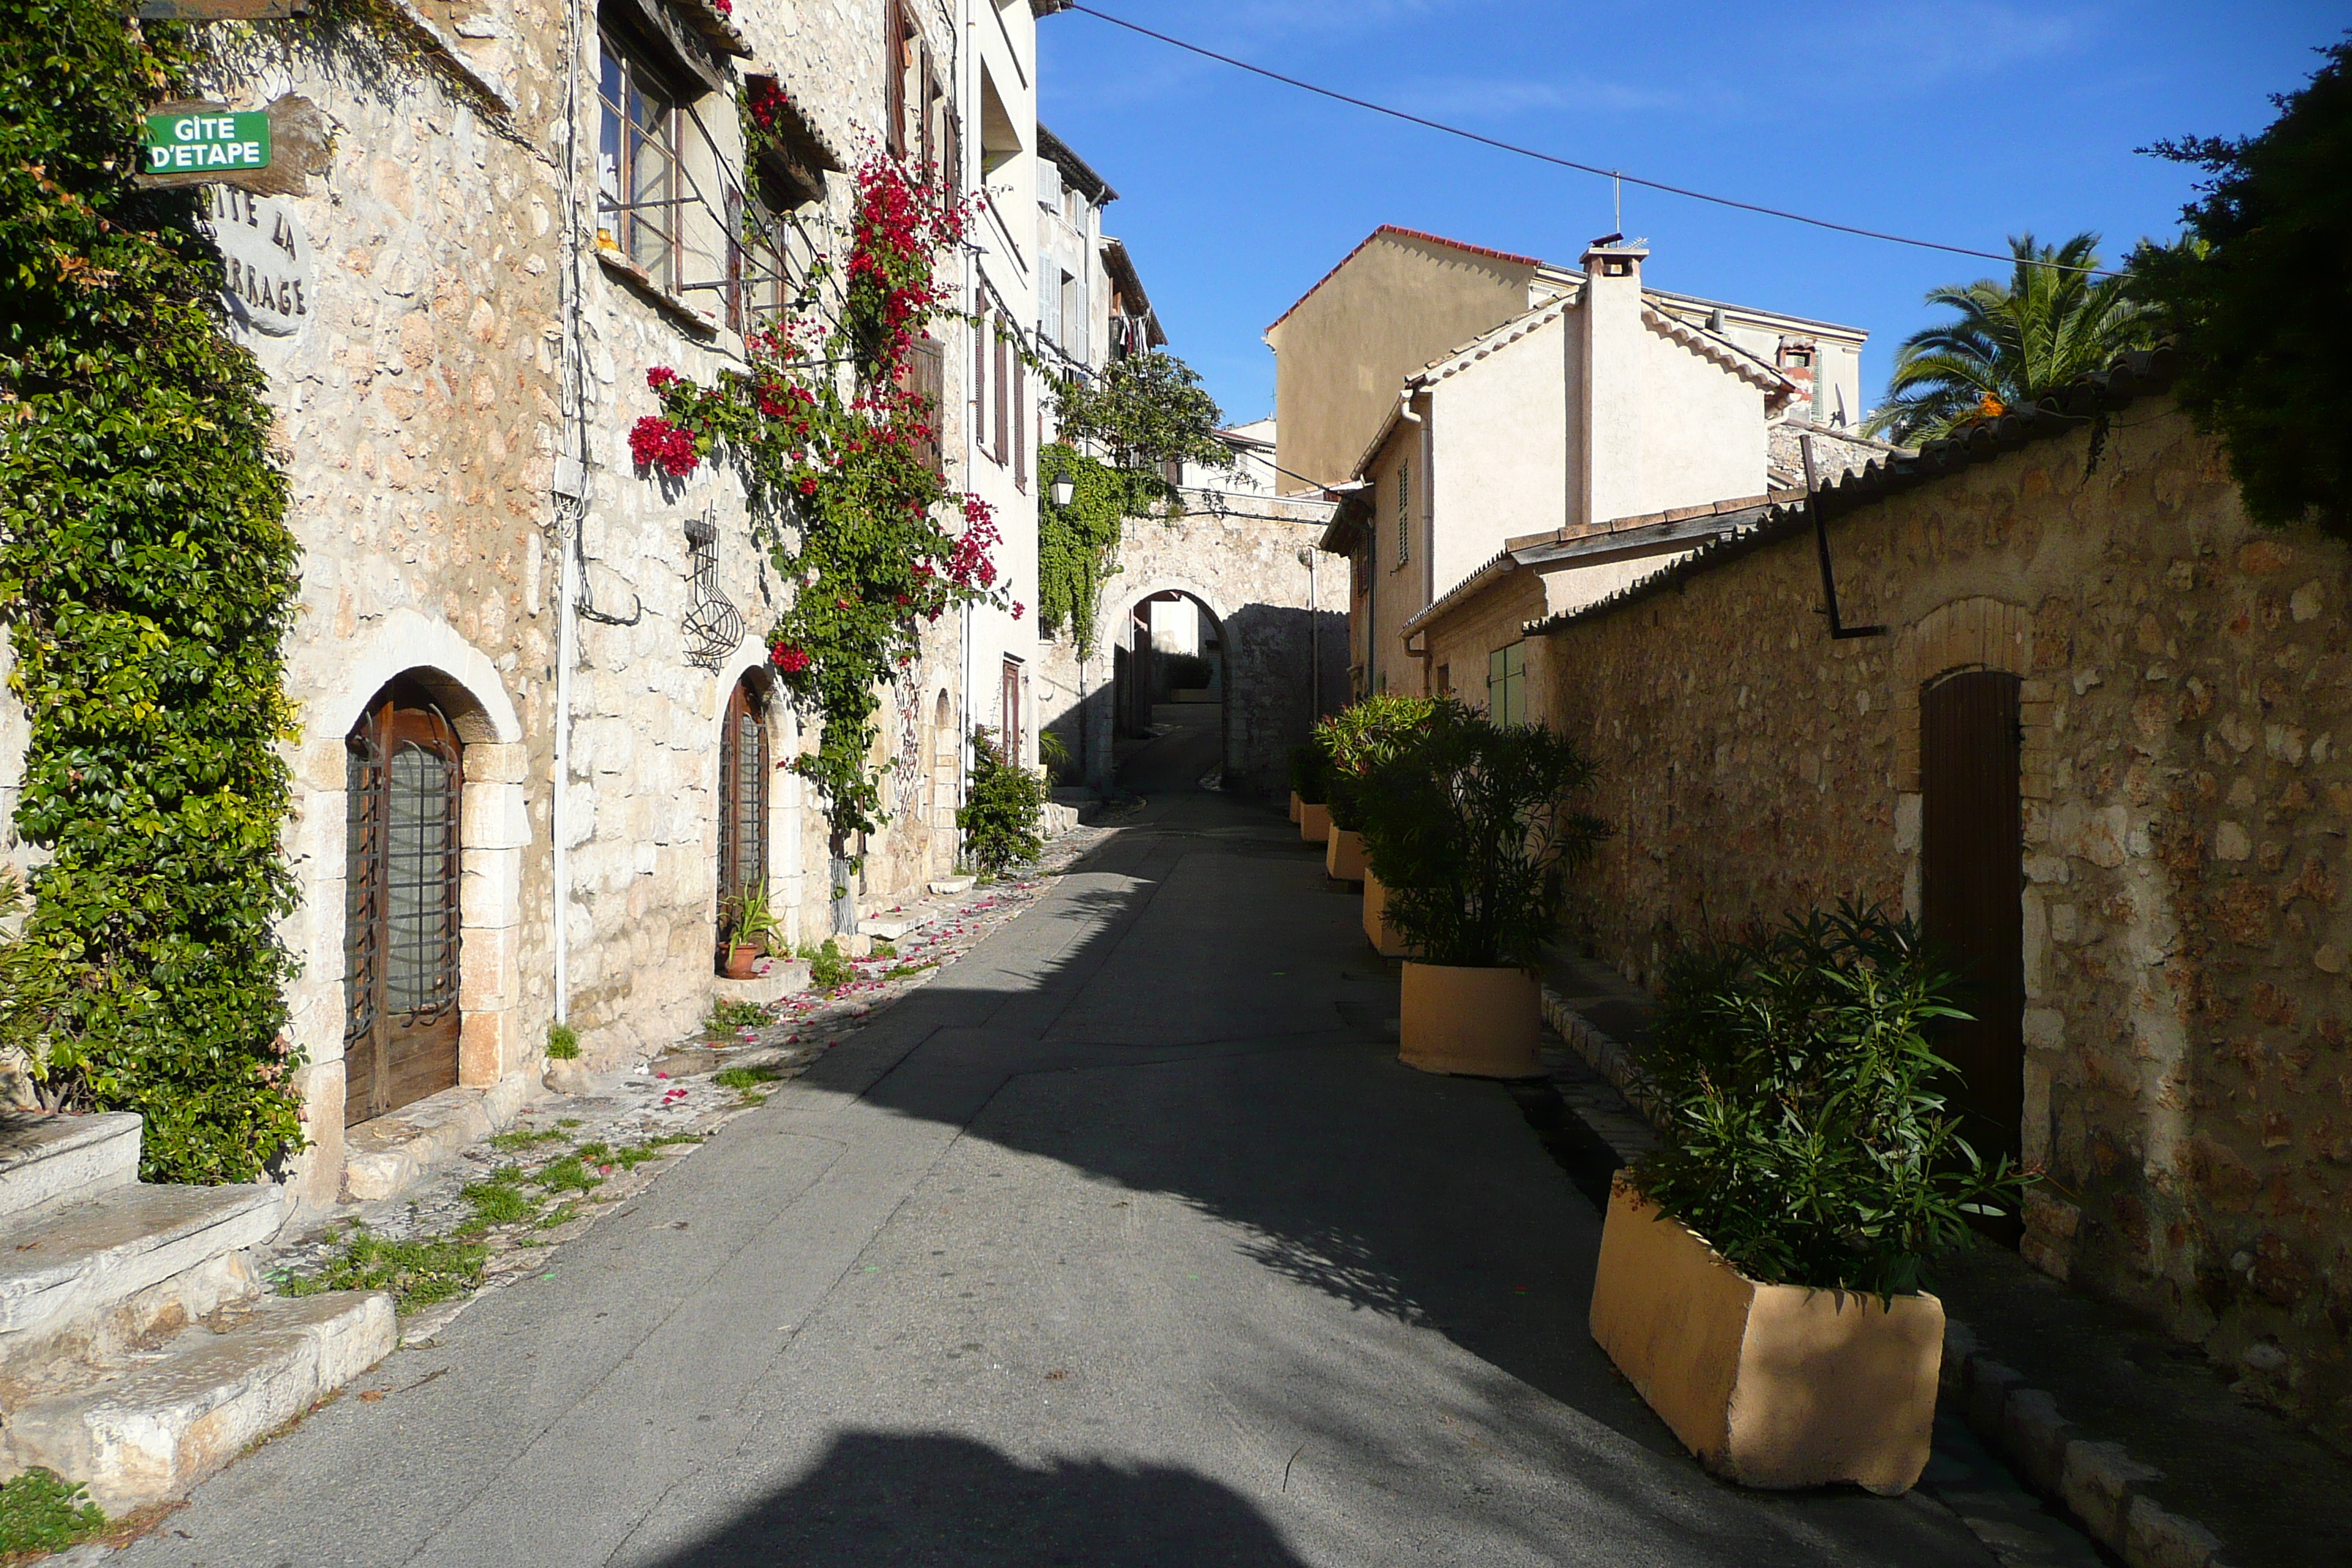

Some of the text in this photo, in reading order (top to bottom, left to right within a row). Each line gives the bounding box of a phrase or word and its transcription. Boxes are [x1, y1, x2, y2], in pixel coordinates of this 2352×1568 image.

[151, 141, 260, 167] D'ETAPE
[208, 184, 297, 262] ITE LA
[224, 257, 306, 317] RRAGE
